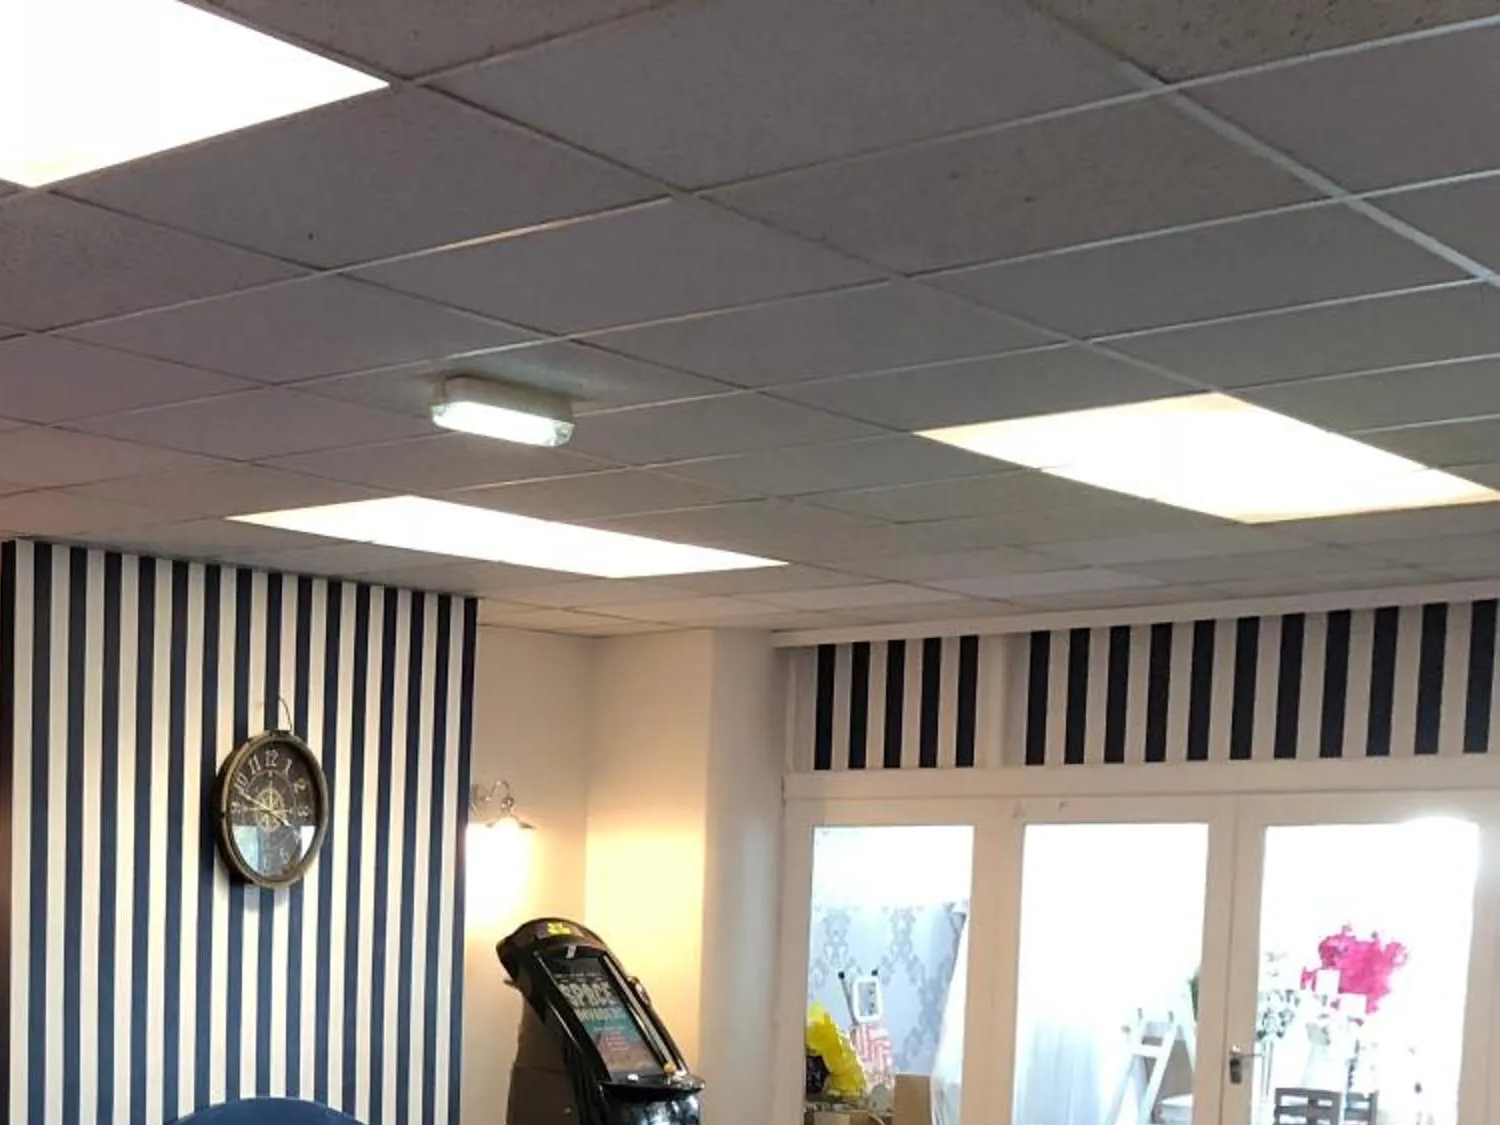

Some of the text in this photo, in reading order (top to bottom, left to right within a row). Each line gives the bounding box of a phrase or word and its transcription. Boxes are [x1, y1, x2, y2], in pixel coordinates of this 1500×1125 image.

[249, 754, 262, 775] 11
[264, 749, 280, 767] 12
[284, 758, 293, 776] 1
[293, 778, 310, 795] 2
